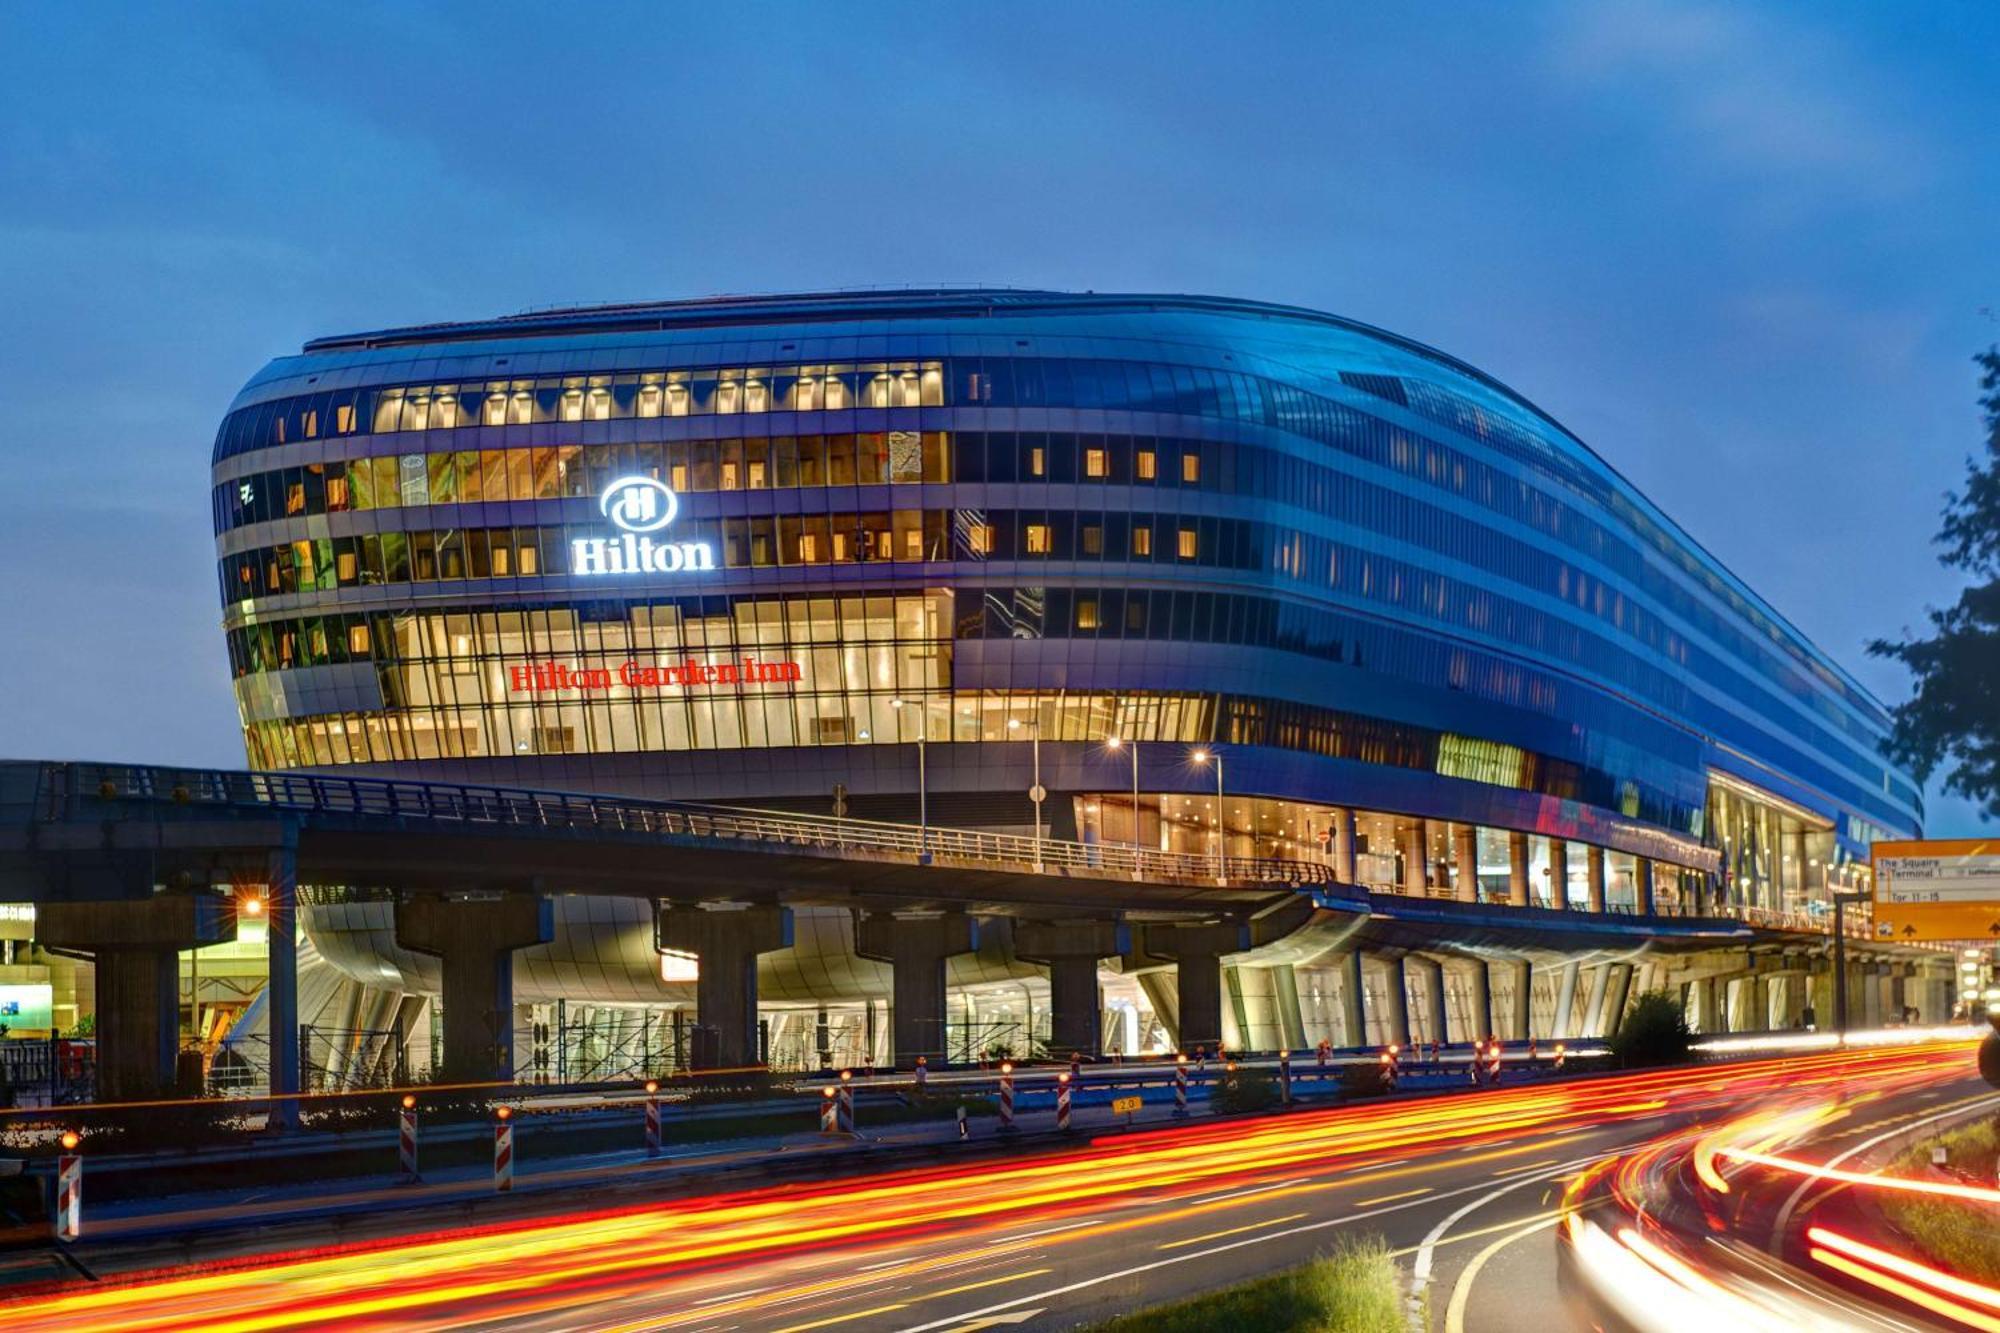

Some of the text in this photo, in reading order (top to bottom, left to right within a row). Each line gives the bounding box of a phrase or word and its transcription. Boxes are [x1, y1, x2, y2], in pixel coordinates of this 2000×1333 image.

[572, 534, 715, 575] Hilton
[510, 657, 802, 691] Hilton Garden Inn
[1892, 869, 1933, 878] Terminal
